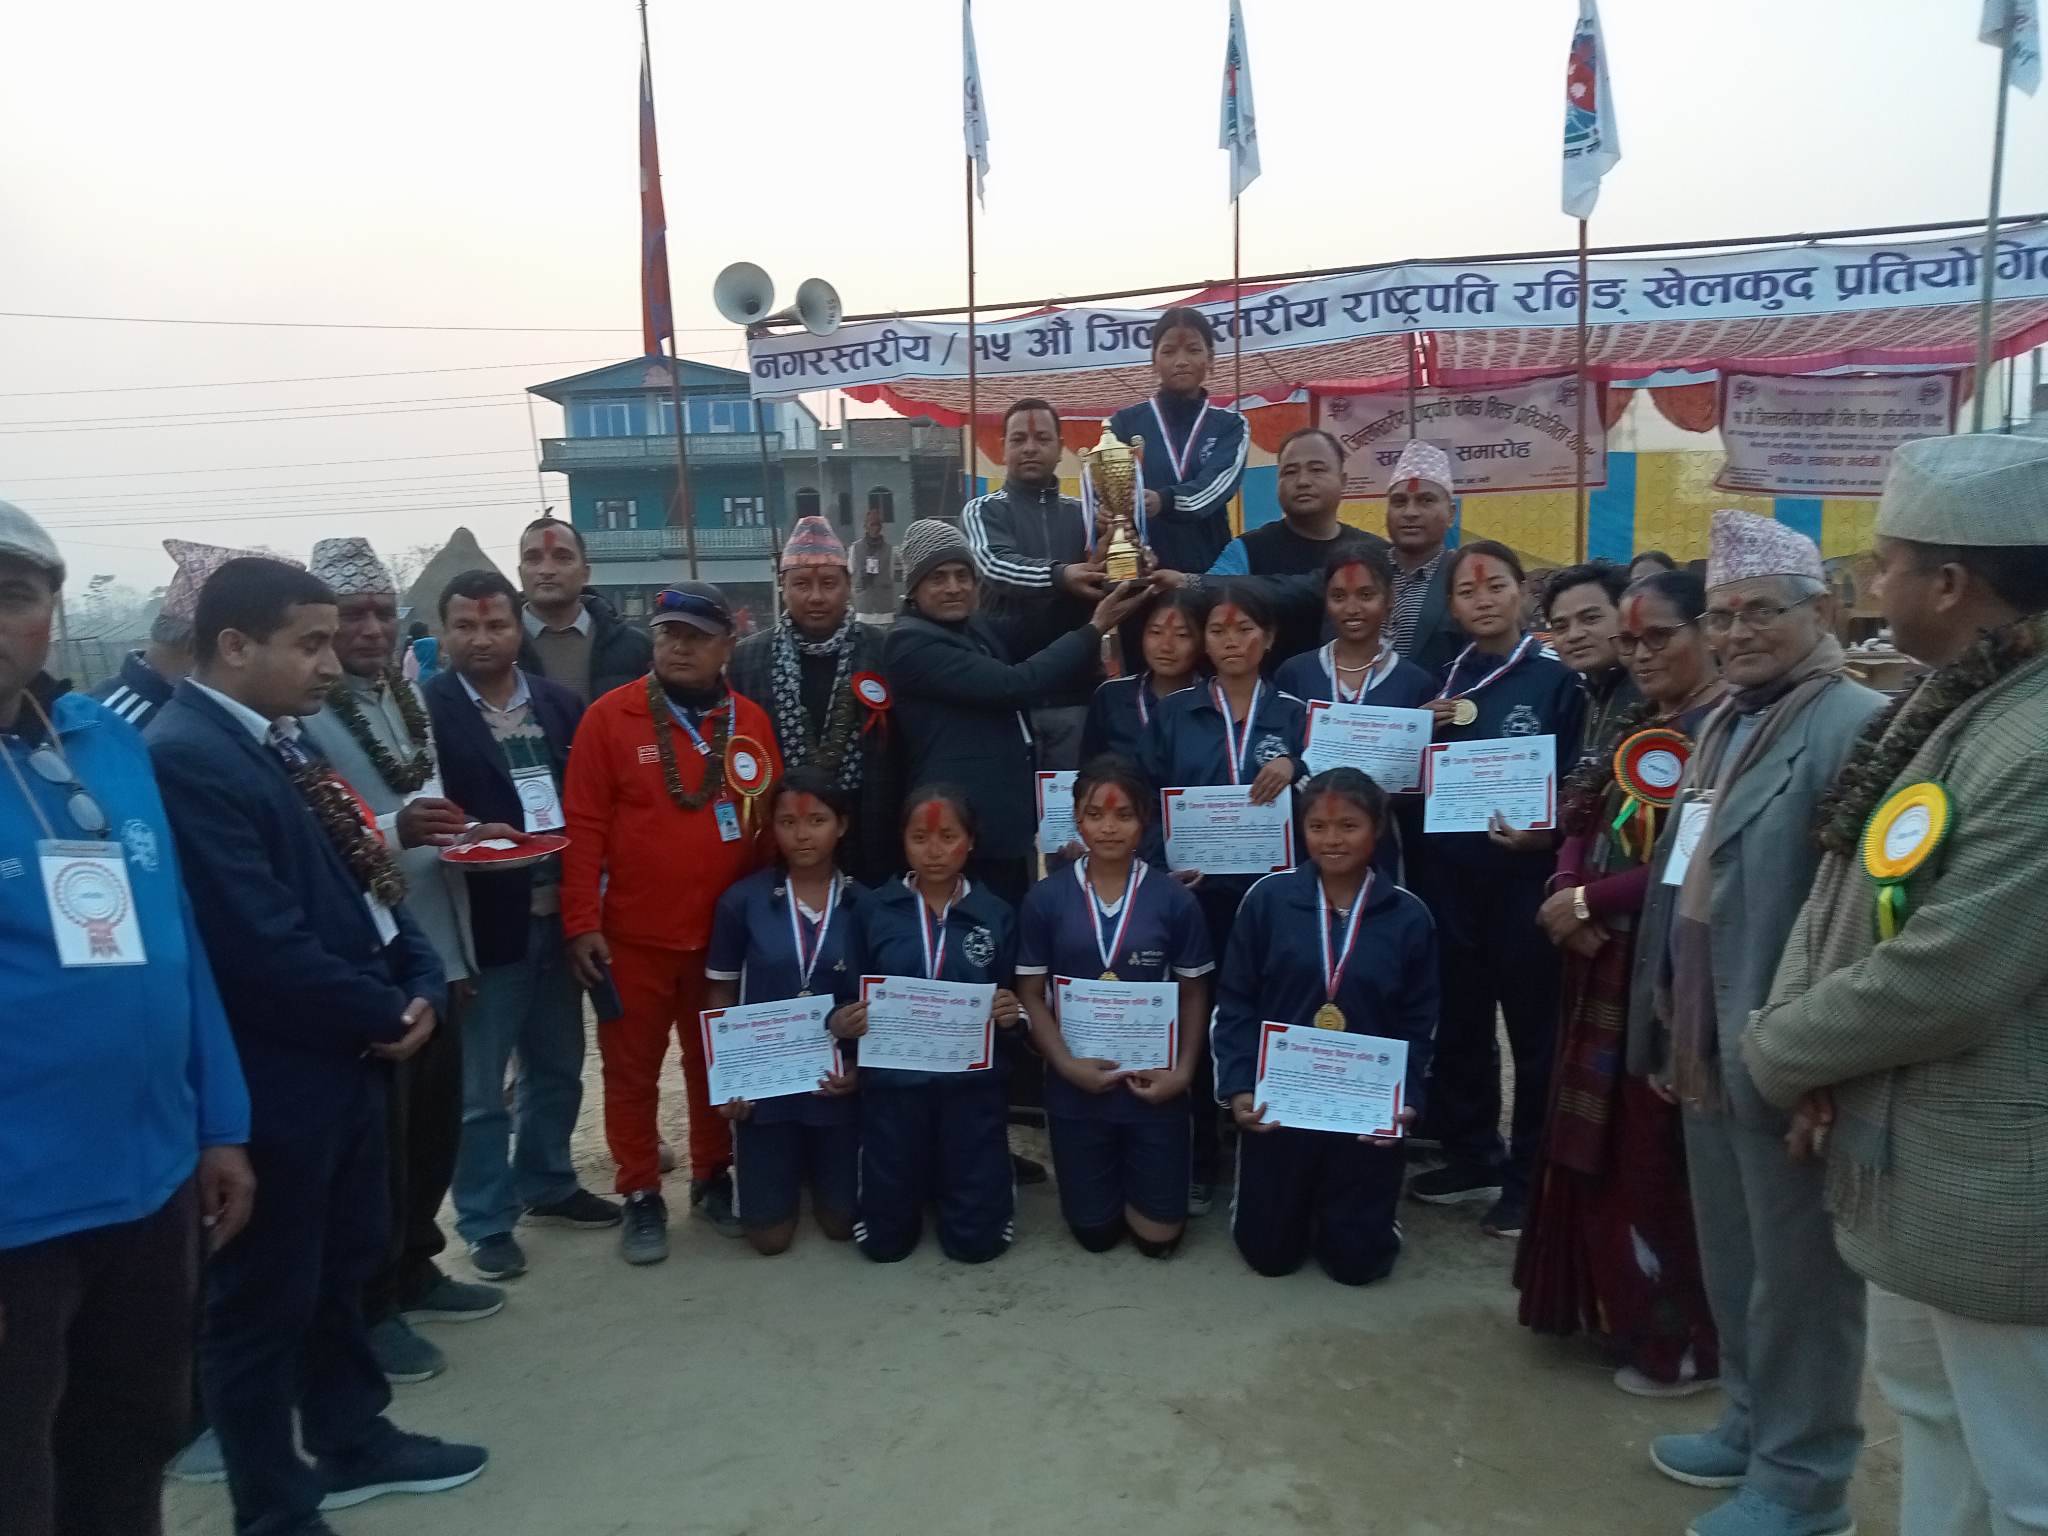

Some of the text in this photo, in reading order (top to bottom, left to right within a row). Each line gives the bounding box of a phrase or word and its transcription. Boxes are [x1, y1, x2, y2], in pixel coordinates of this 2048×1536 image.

[753, 328, 931, 379] नगरस्तरीय
[940, 332, 958, 366] /
[1343, 273, 1499, 324] राष्ट्रपति
[1642, 267, 1820, 311] खेलकुद
[1835, 239, 2048, 301] प्रतियोगि
[1455, 438, 1533, 462] समारोह
